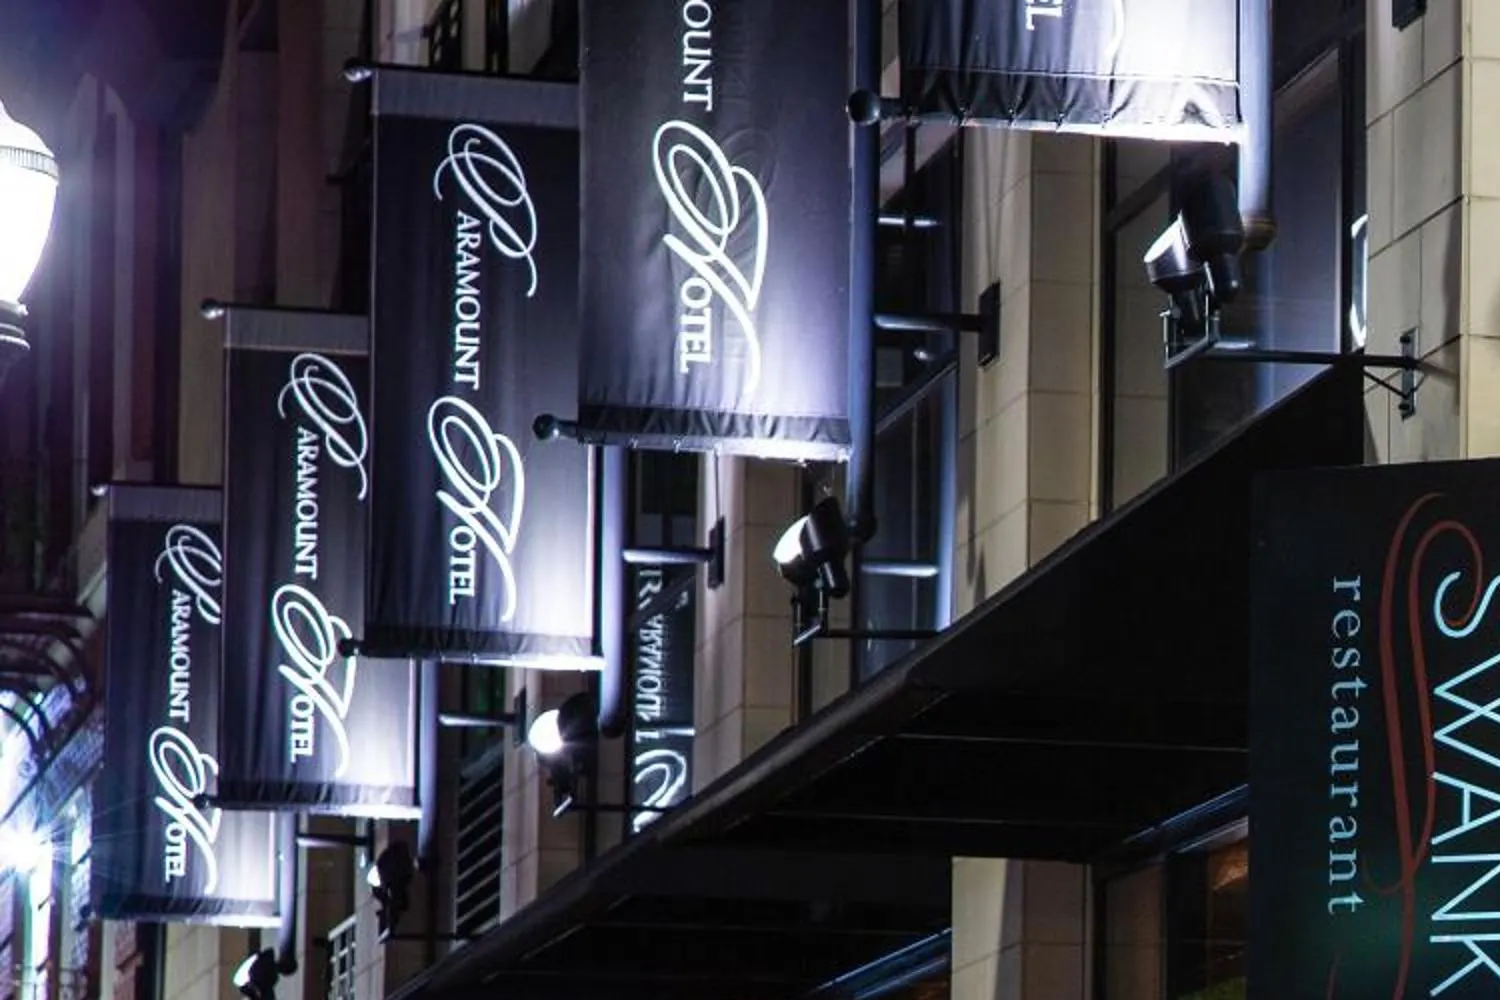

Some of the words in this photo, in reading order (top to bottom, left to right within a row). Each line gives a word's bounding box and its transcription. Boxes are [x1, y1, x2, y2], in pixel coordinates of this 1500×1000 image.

[683, 0, 712, 111] OUNT
[433, 123, 538, 391] PARAMOUNT
[653, 120, 768, 395] HOTEL
[277, 353, 368, 580] PARAMOUNT
[428, 395, 525, 623] HOTEL
[154, 524, 222, 723] PARAMOUNT
[272, 584, 357, 778] HOTEL
[149, 726, 223, 895] HOTEL
[1328, 575, 1368, 915] restaurant
